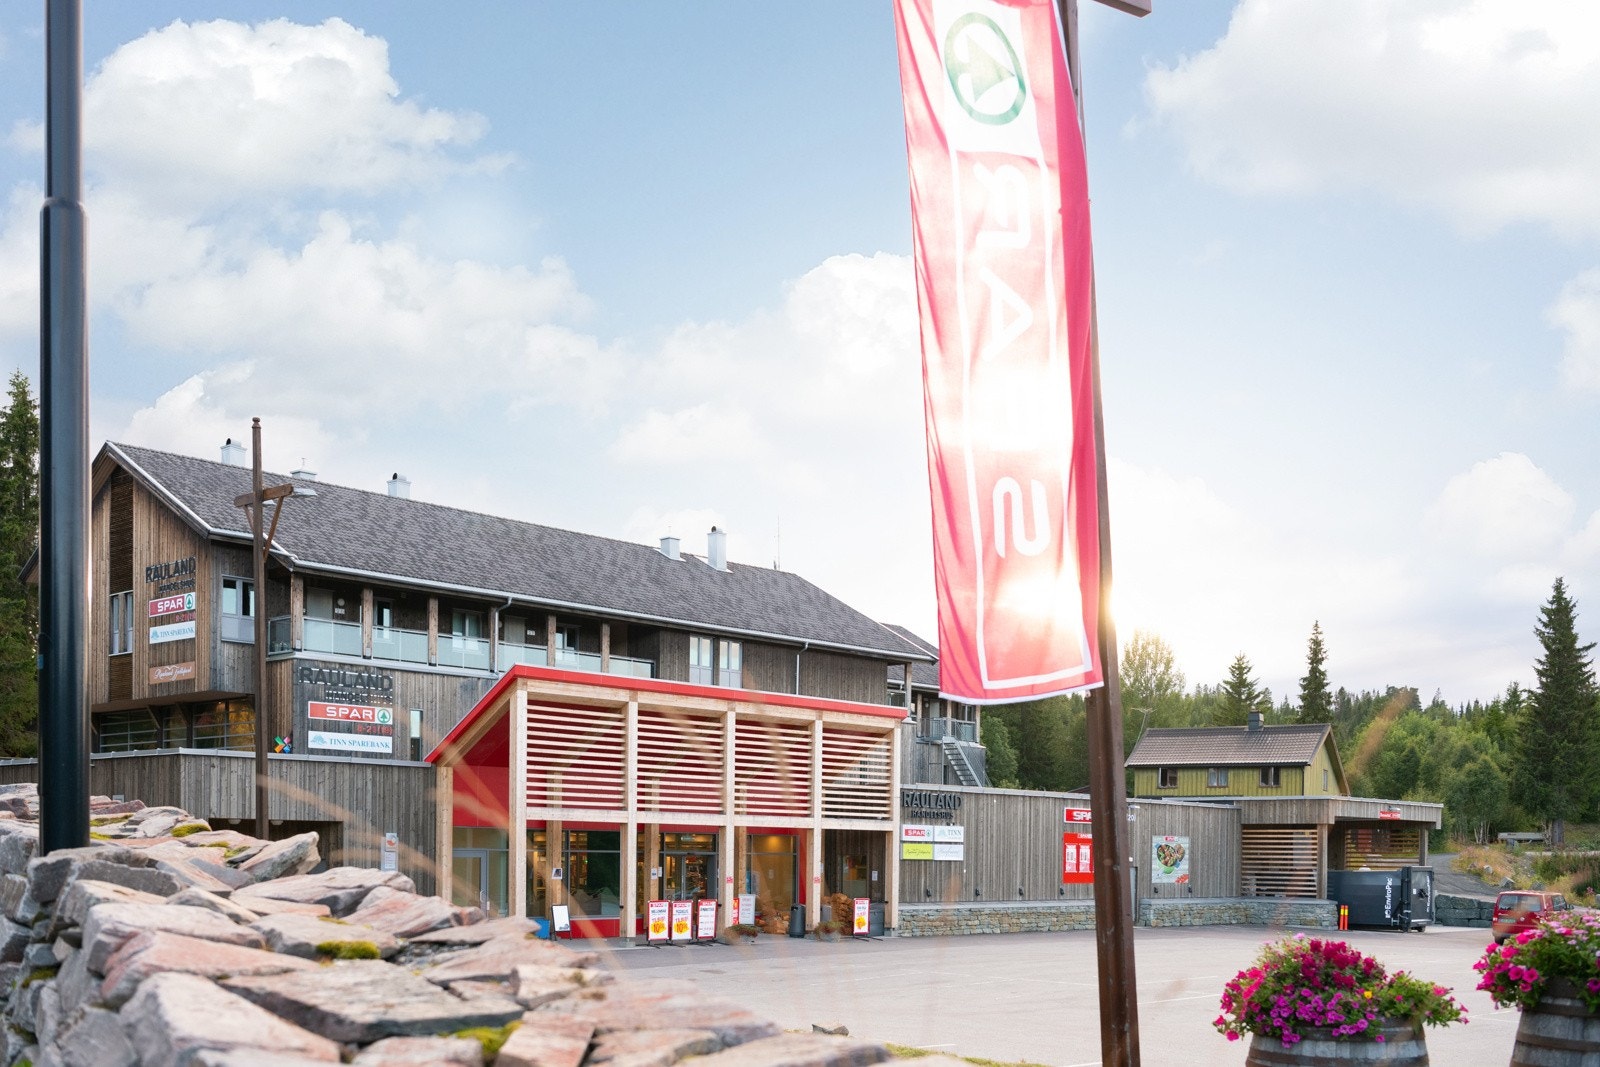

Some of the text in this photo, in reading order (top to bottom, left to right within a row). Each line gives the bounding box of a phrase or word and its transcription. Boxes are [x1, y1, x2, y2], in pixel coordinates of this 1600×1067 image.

[145, 556, 196, 583] RAULAND
[157, 598, 183, 612] SPAR
[299, 666, 393, 692] RAULAND
[326, 706, 373, 720] SPAR
[348, 740, 390, 749] SPAREBANK
[902, 791, 961, 810] RAULAND
[911, 810, 954, 819] HANDELSHUS
[1385, 877, 1393, 910] EnviroPac
